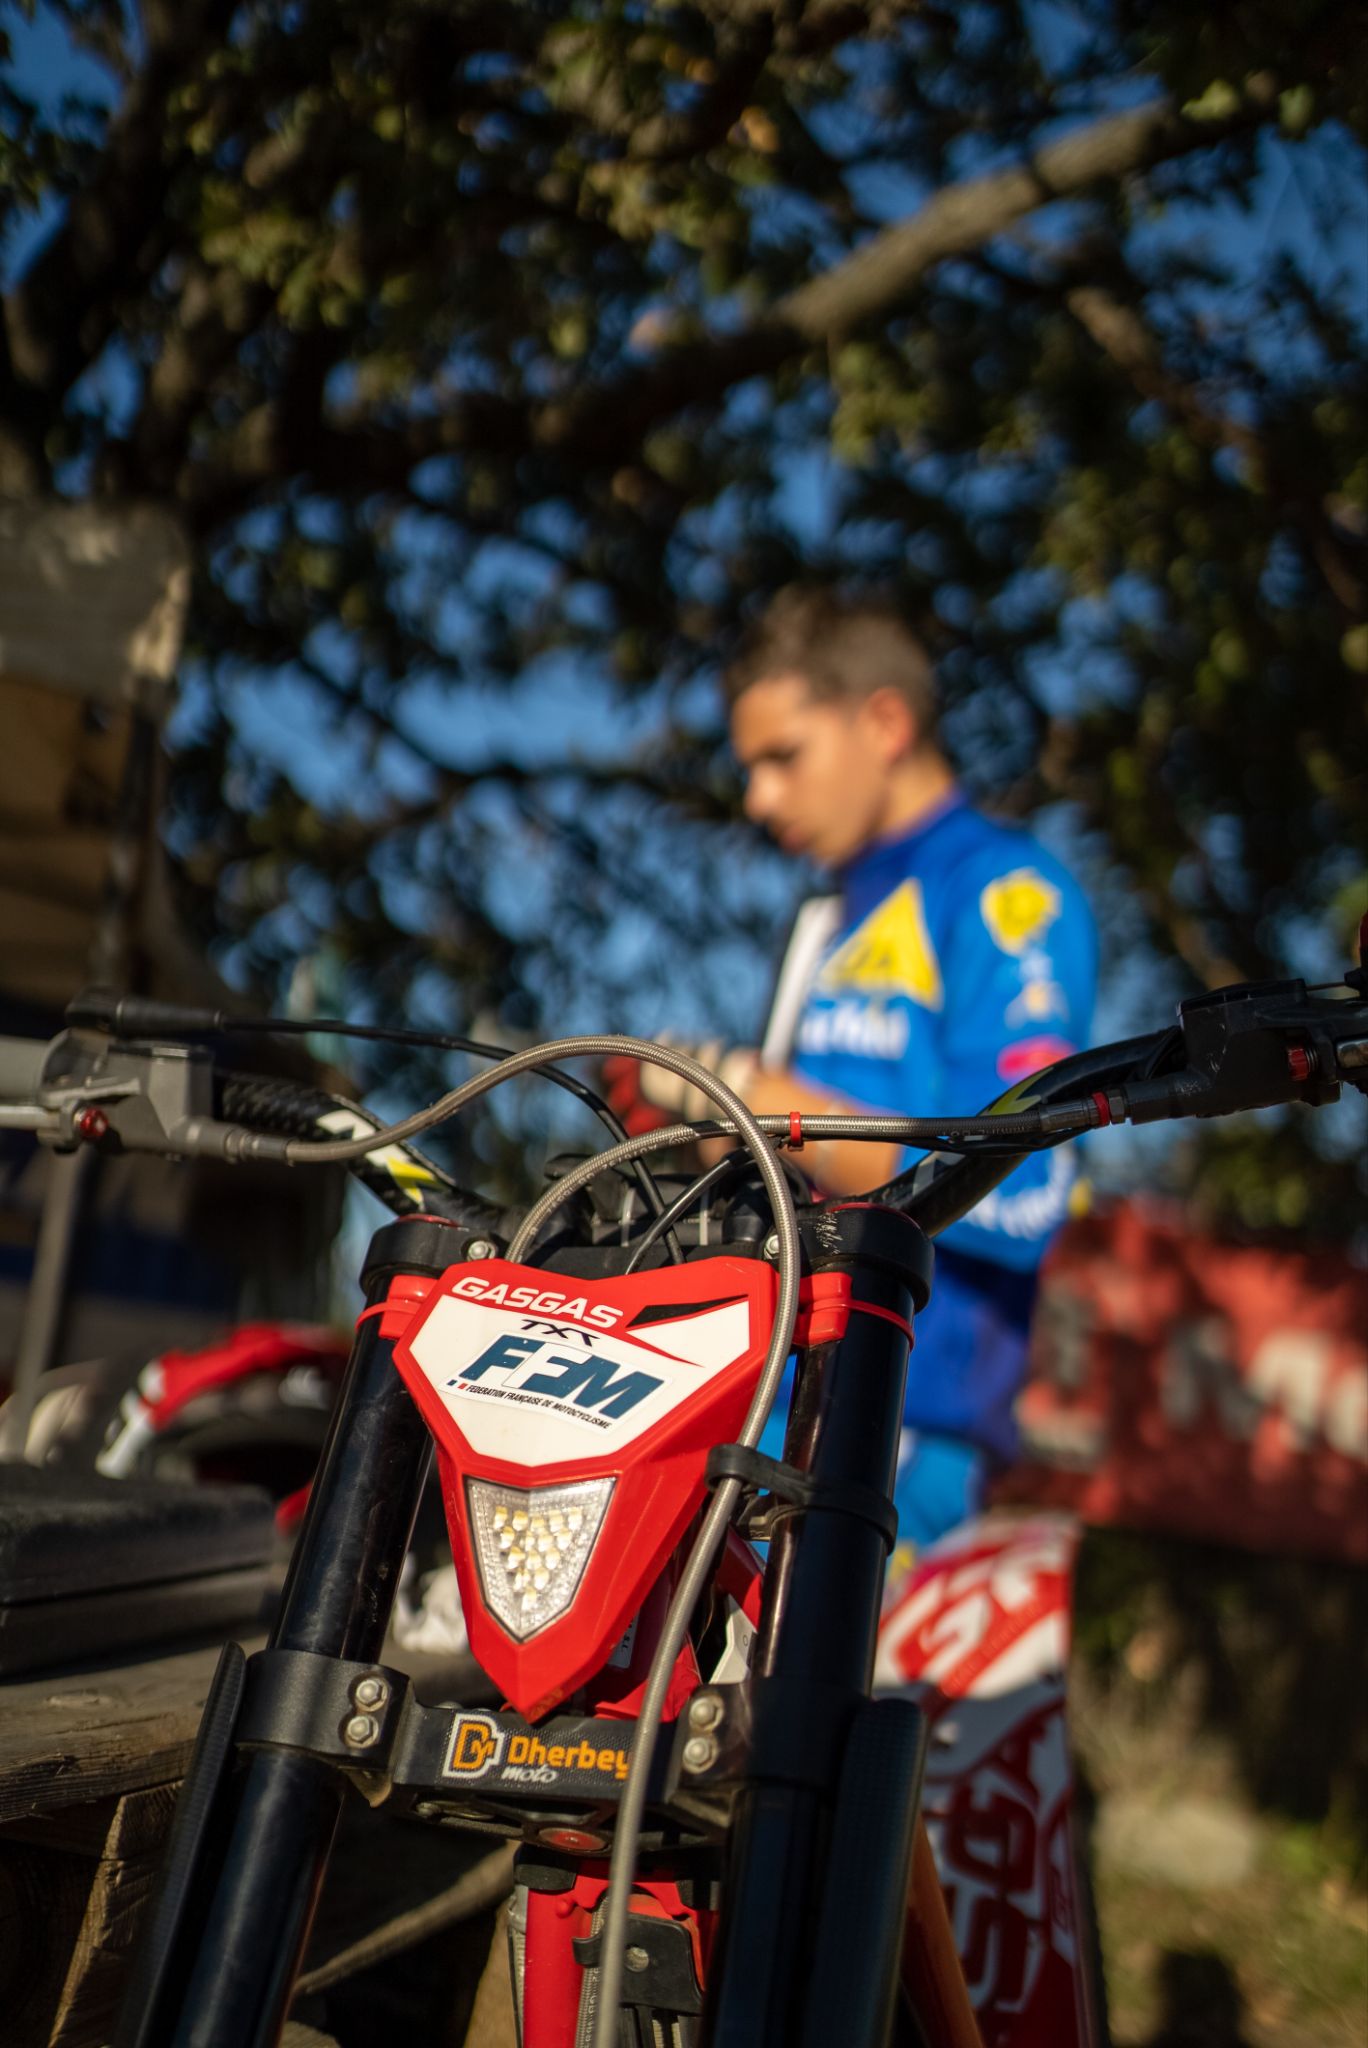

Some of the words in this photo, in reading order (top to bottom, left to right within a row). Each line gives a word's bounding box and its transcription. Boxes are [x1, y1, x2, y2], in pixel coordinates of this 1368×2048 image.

[451, 1276, 624, 1328] GASGAS
[521, 1319, 600, 1347] TXT
[541, 1399, 554, 1408] DE
[552, 1402, 612, 1430] MOTOCYCLISME
[507, 1735, 630, 1780] Dherbey
[501, 1764, 559, 1784] moto
